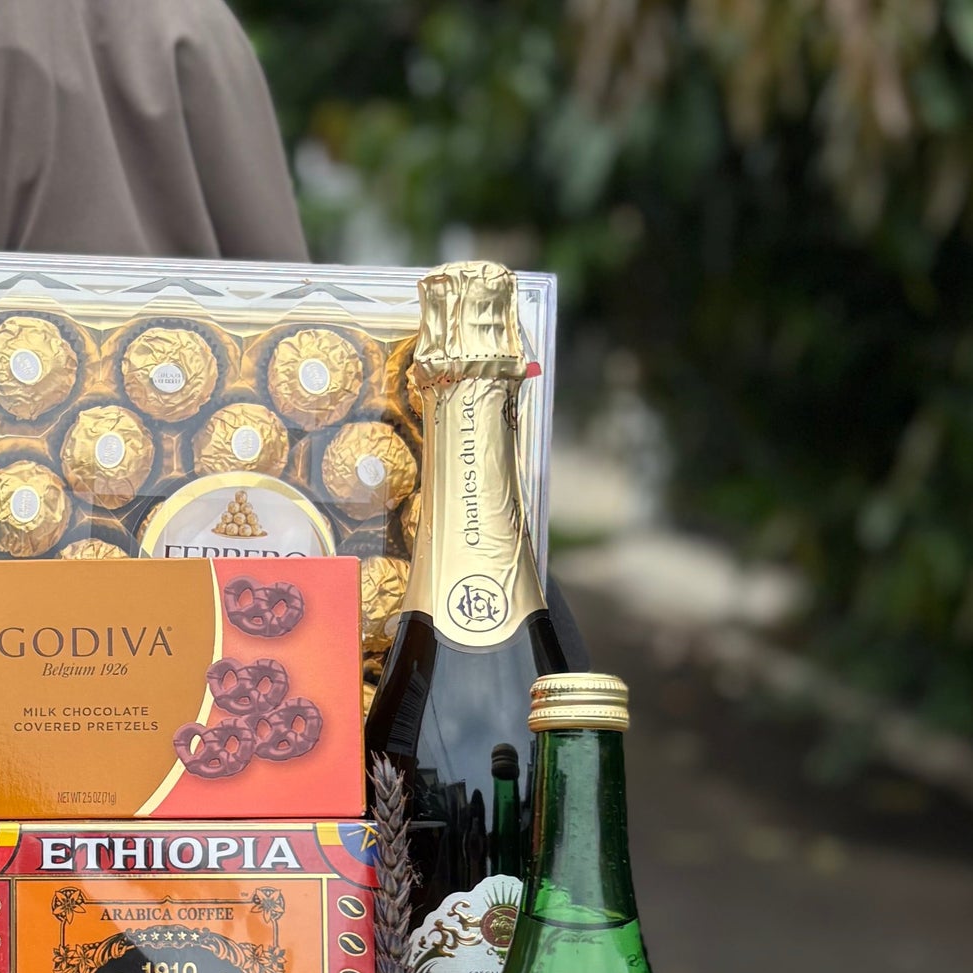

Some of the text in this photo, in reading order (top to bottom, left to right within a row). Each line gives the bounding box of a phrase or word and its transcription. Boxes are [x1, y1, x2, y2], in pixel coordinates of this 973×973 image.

[460, 395, 481, 547] Charles du Lac
[42, 662, 128, 678] Belgium 1926
[23, 706, 149, 717] MILK CHOCOLATE
[14, 721, 159, 732] COVERED PRETZELS
[57, 792, 70, 803] NET
[71, 792, 81, 803] WT
[40, 837, 302, 871] ETHIOPIA
[101, 908, 234, 921] ARABICA COFFEE
